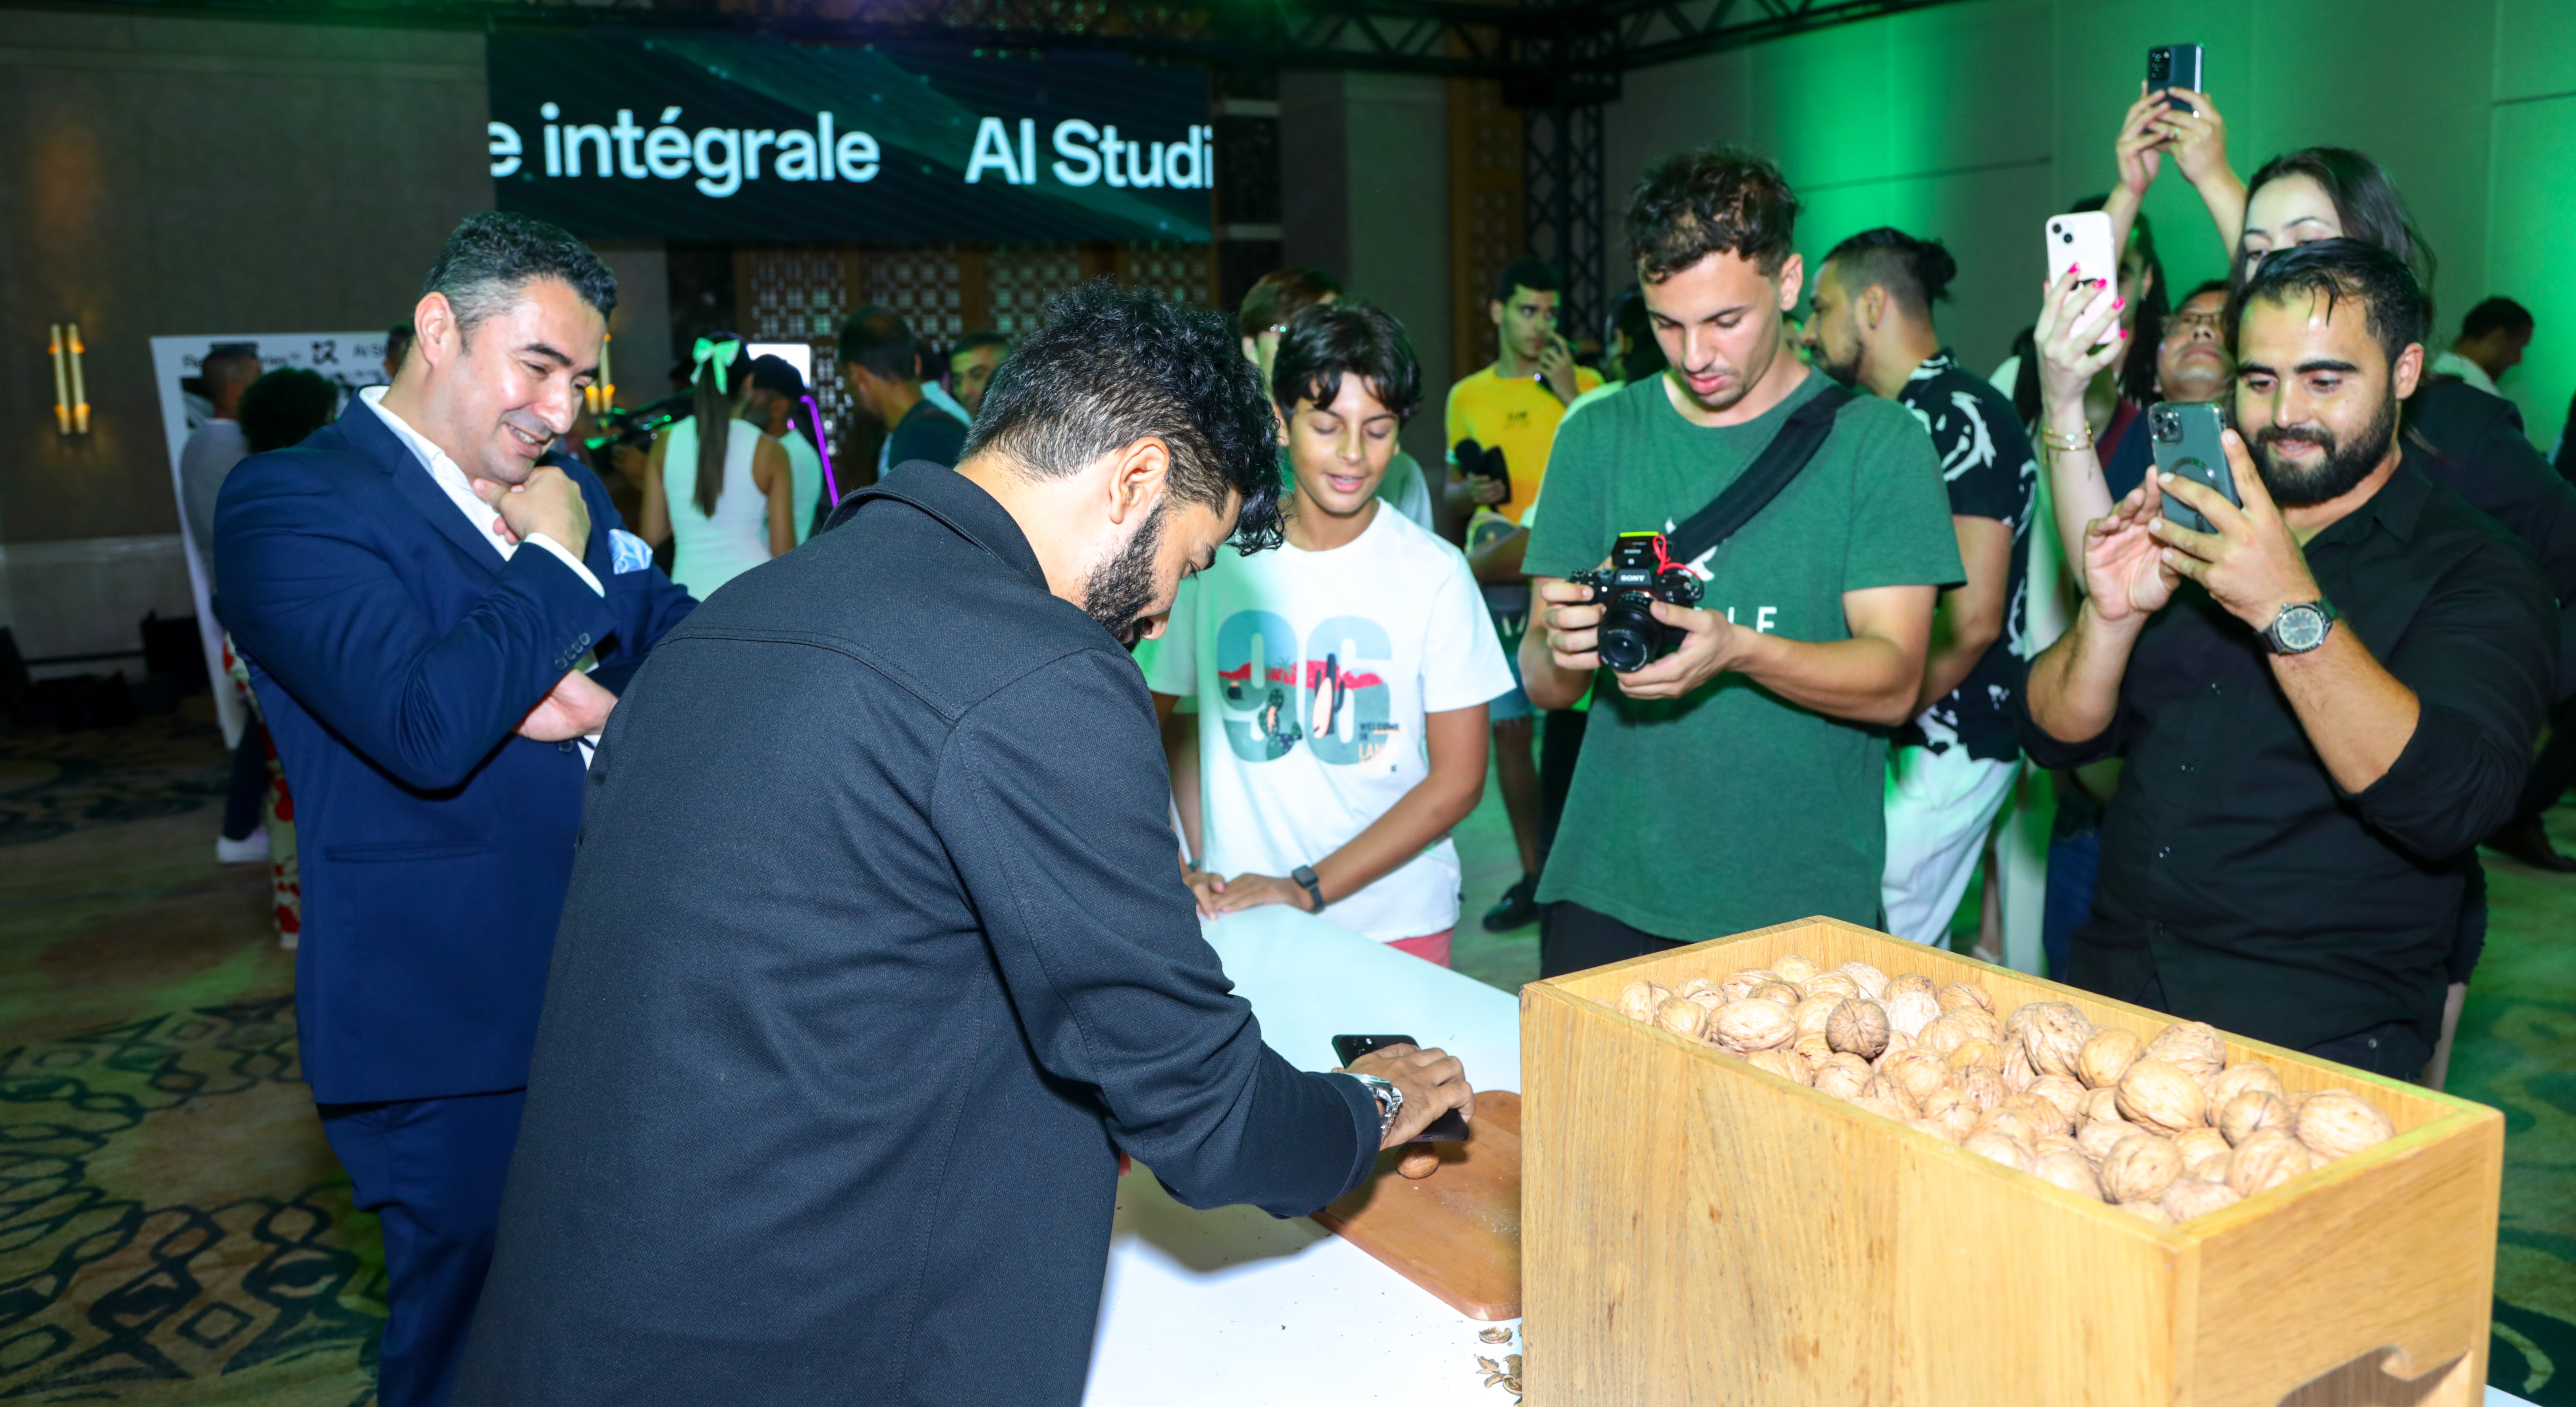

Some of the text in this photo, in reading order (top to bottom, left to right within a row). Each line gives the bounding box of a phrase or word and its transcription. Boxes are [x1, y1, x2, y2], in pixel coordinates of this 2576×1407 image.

[540, 102, 880, 198] intégrale
[964, 117, 1037, 185] AI
[1051, 119, 1213, 189] Studi
[1217, 609, 1392, 765] 96
[1359, 722, 1399, 731] WELCOME
